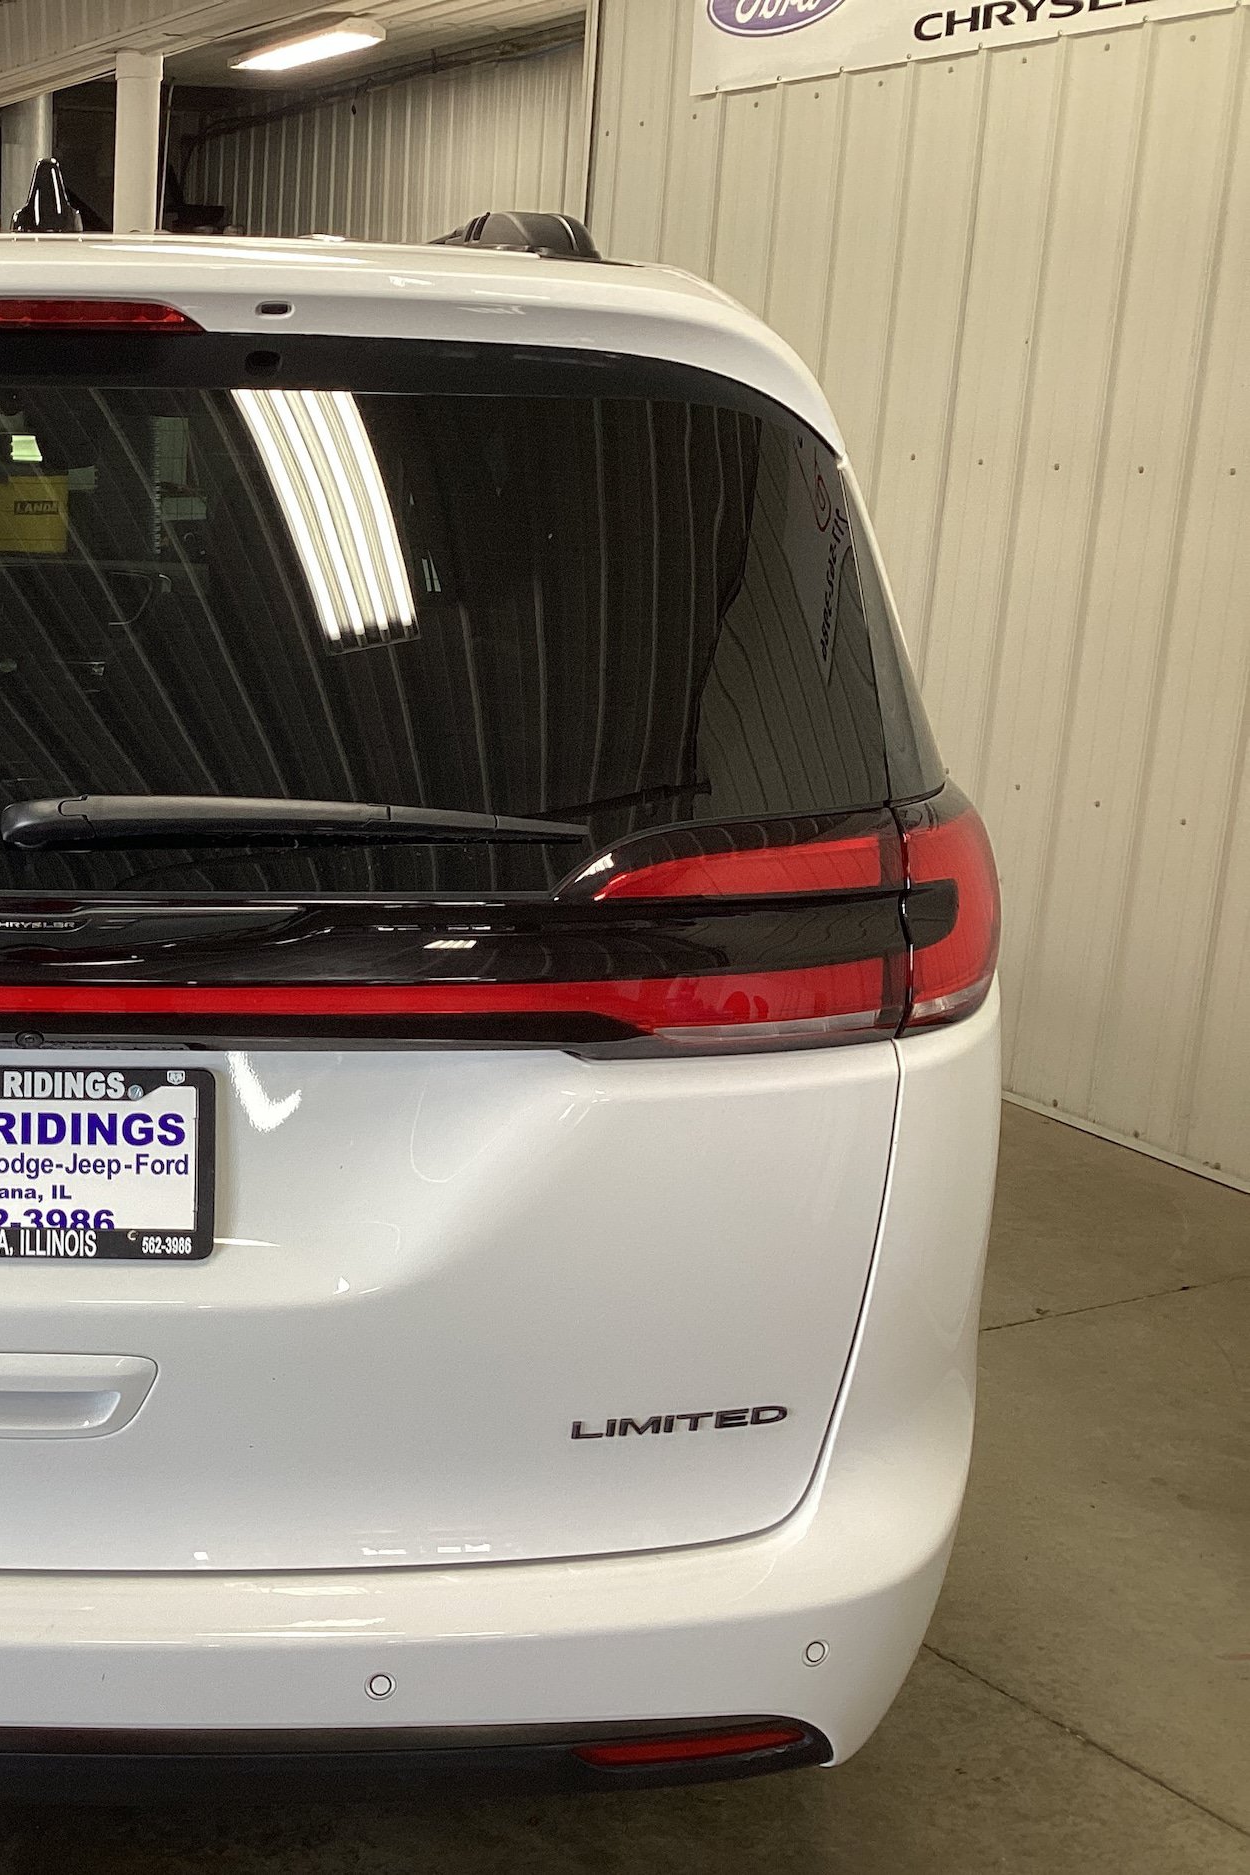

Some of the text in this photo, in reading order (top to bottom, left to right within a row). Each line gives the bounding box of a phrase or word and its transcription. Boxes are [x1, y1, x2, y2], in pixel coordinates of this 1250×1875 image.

[3, 1071, 126, 1099] RIDINGS
[51, 1185, 72, 1200] IL
[20, 1230, 98, 1257] ILLINOIS
[142, 1236, 192, 1254] 562-3986
[571, 1405, 788, 1439] LIMITED
